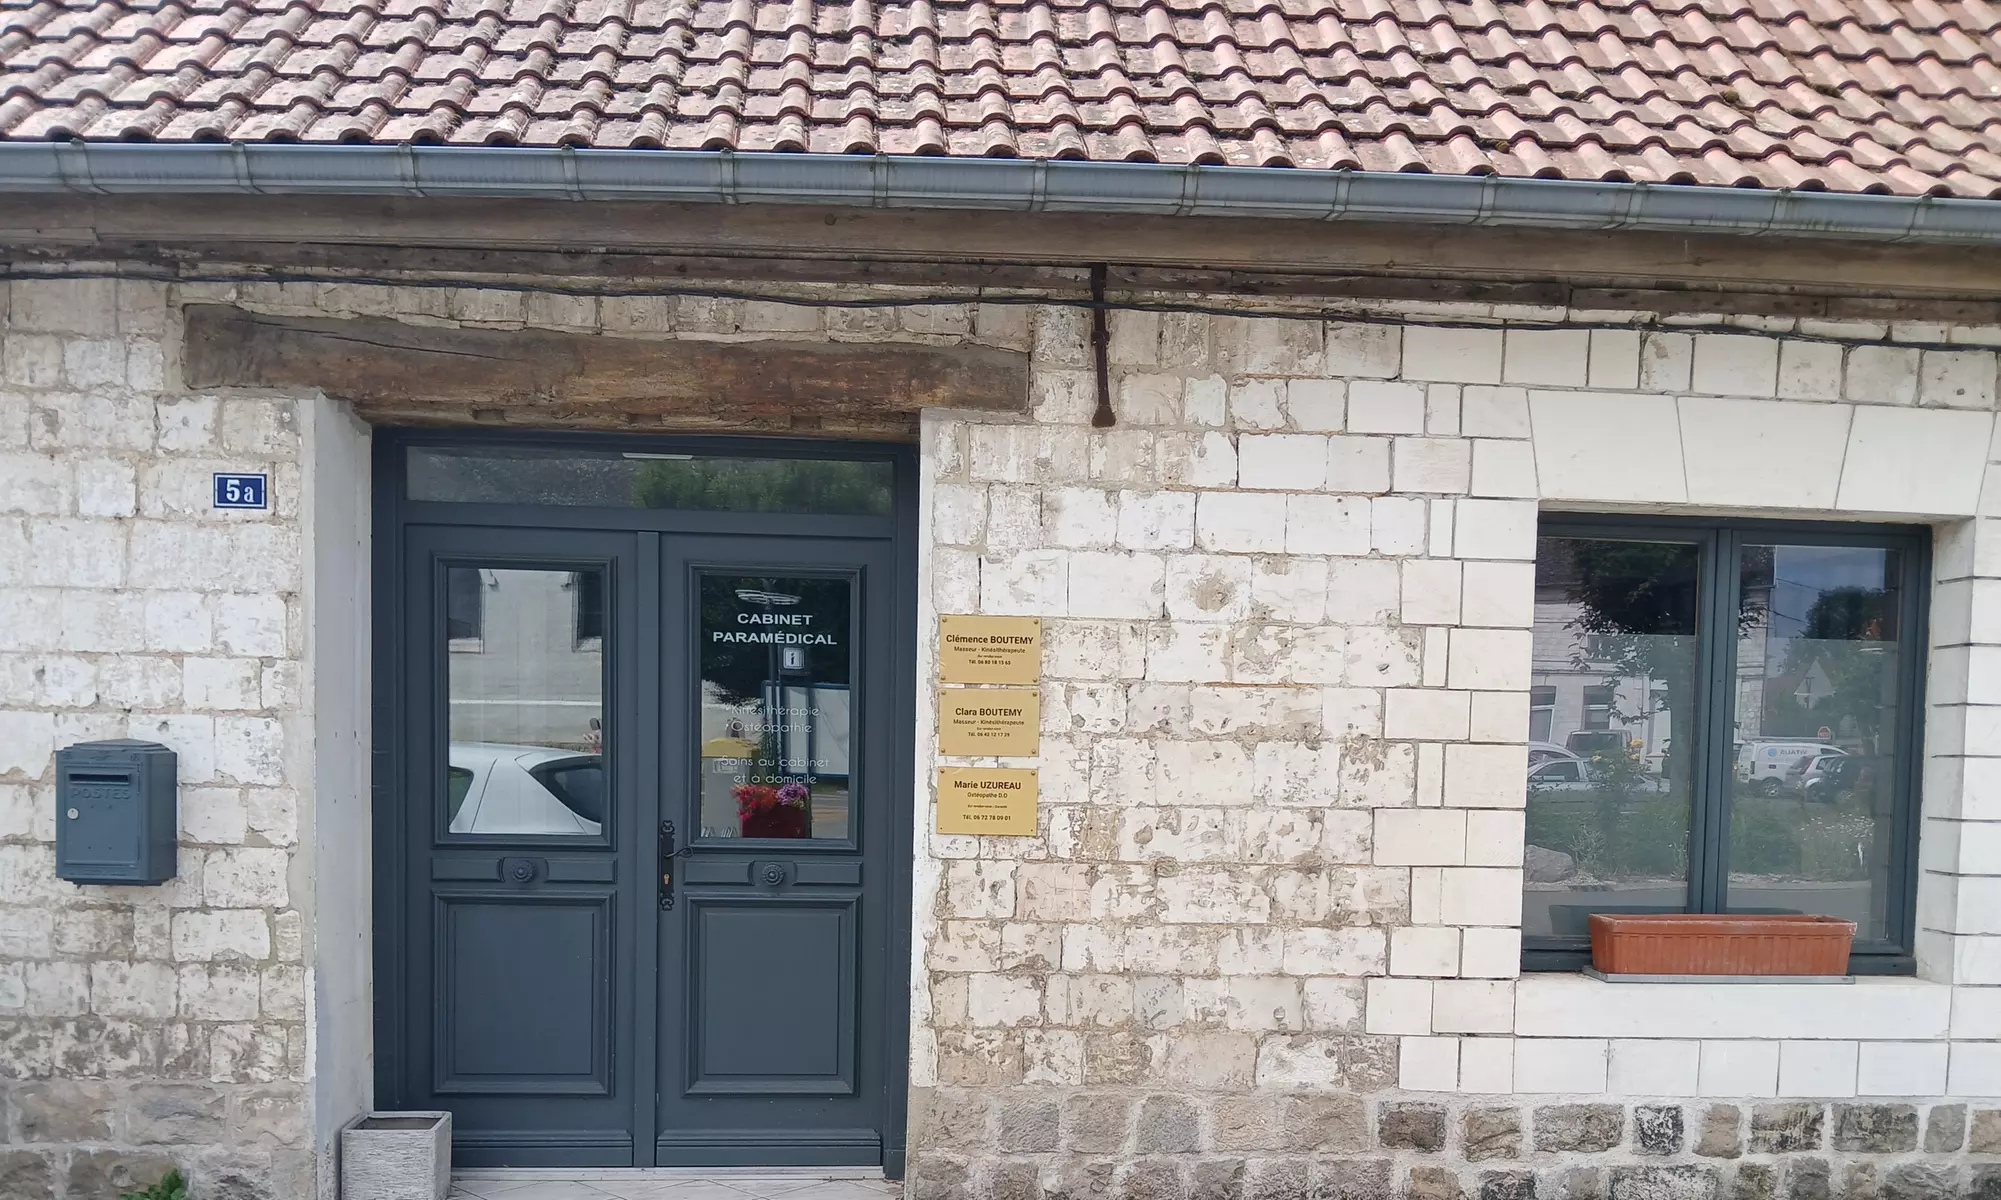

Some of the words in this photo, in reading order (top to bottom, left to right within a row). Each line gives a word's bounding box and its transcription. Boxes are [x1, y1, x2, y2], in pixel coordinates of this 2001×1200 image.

[226, 479, 255, 502] 5a
[737, 613, 813, 625] CABINET
[713, 631, 838, 645] PARAMÉDICAL
[946, 634, 988, 643] Clémence
[990, 636, 1034, 645] BOUTEMY
[955, 708, 977, 716] Clara
[979, 708, 1023, 716] BOUTEMY
[721, 756, 753, 766] Soins
[780, 757, 829, 767] cabinet
[734, 775, 746, 783] et
[752, 774, 760, 783] à
[766, 774, 817, 784] domicile
[980, 782, 1021, 790] UZUREAU
